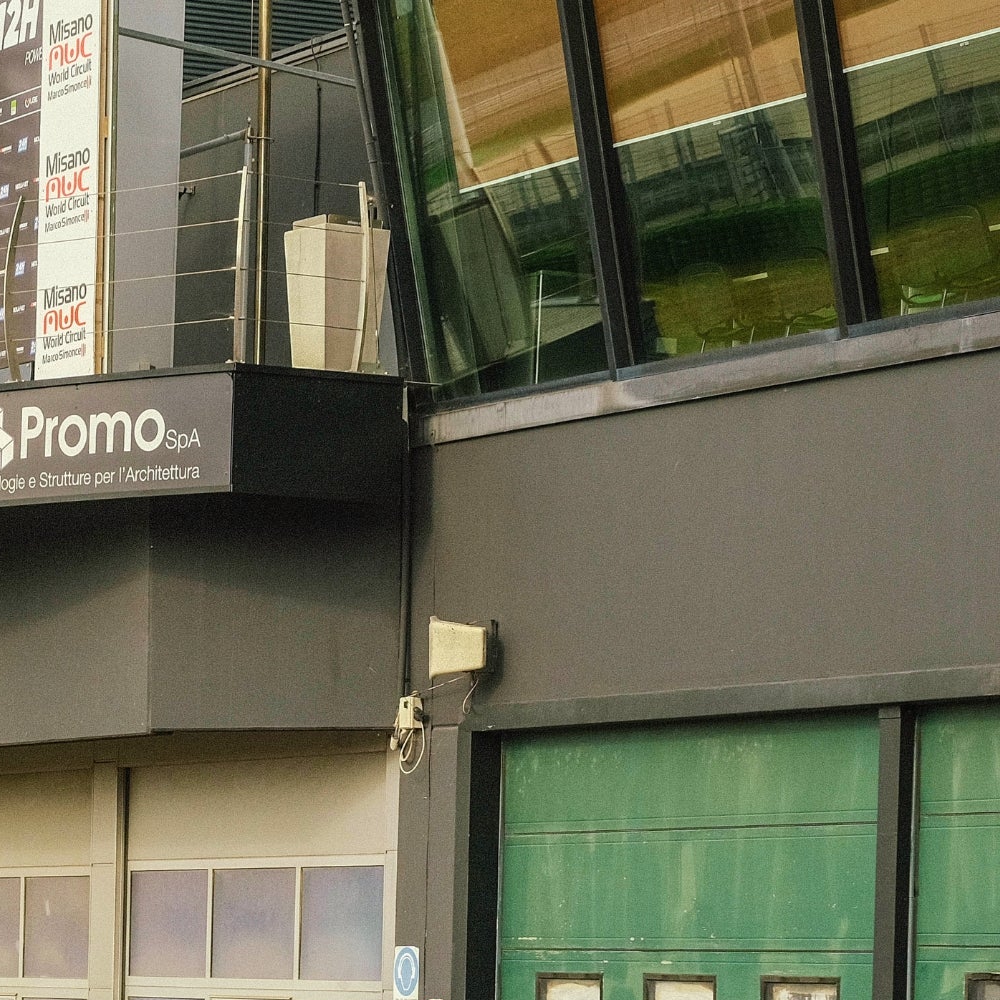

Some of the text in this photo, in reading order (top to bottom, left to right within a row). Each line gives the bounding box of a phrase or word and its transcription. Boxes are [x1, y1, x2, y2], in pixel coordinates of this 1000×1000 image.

[49, 13, 93, 46] Misano
[49, 59, 92, 86] World Circuit
[47, 83, 65, 101] Marco
[46, 148, 90, 177] Misano
[45, 192, 89, 218] World Circuit
[44, 216, 61, 232] Marco
[44, 283, 87, 310] Misano
[43, 328, 86, 350] World Circuit
[42, 350, 59, 364] Marco
[20, 406, 200, 459] Promo SpA
[28, 476, 36, 487] e
[39, 471, 91, 488] Strutture
[94, 470, 115, 487] per
[119, 464, 200, 483] l'Architettura
